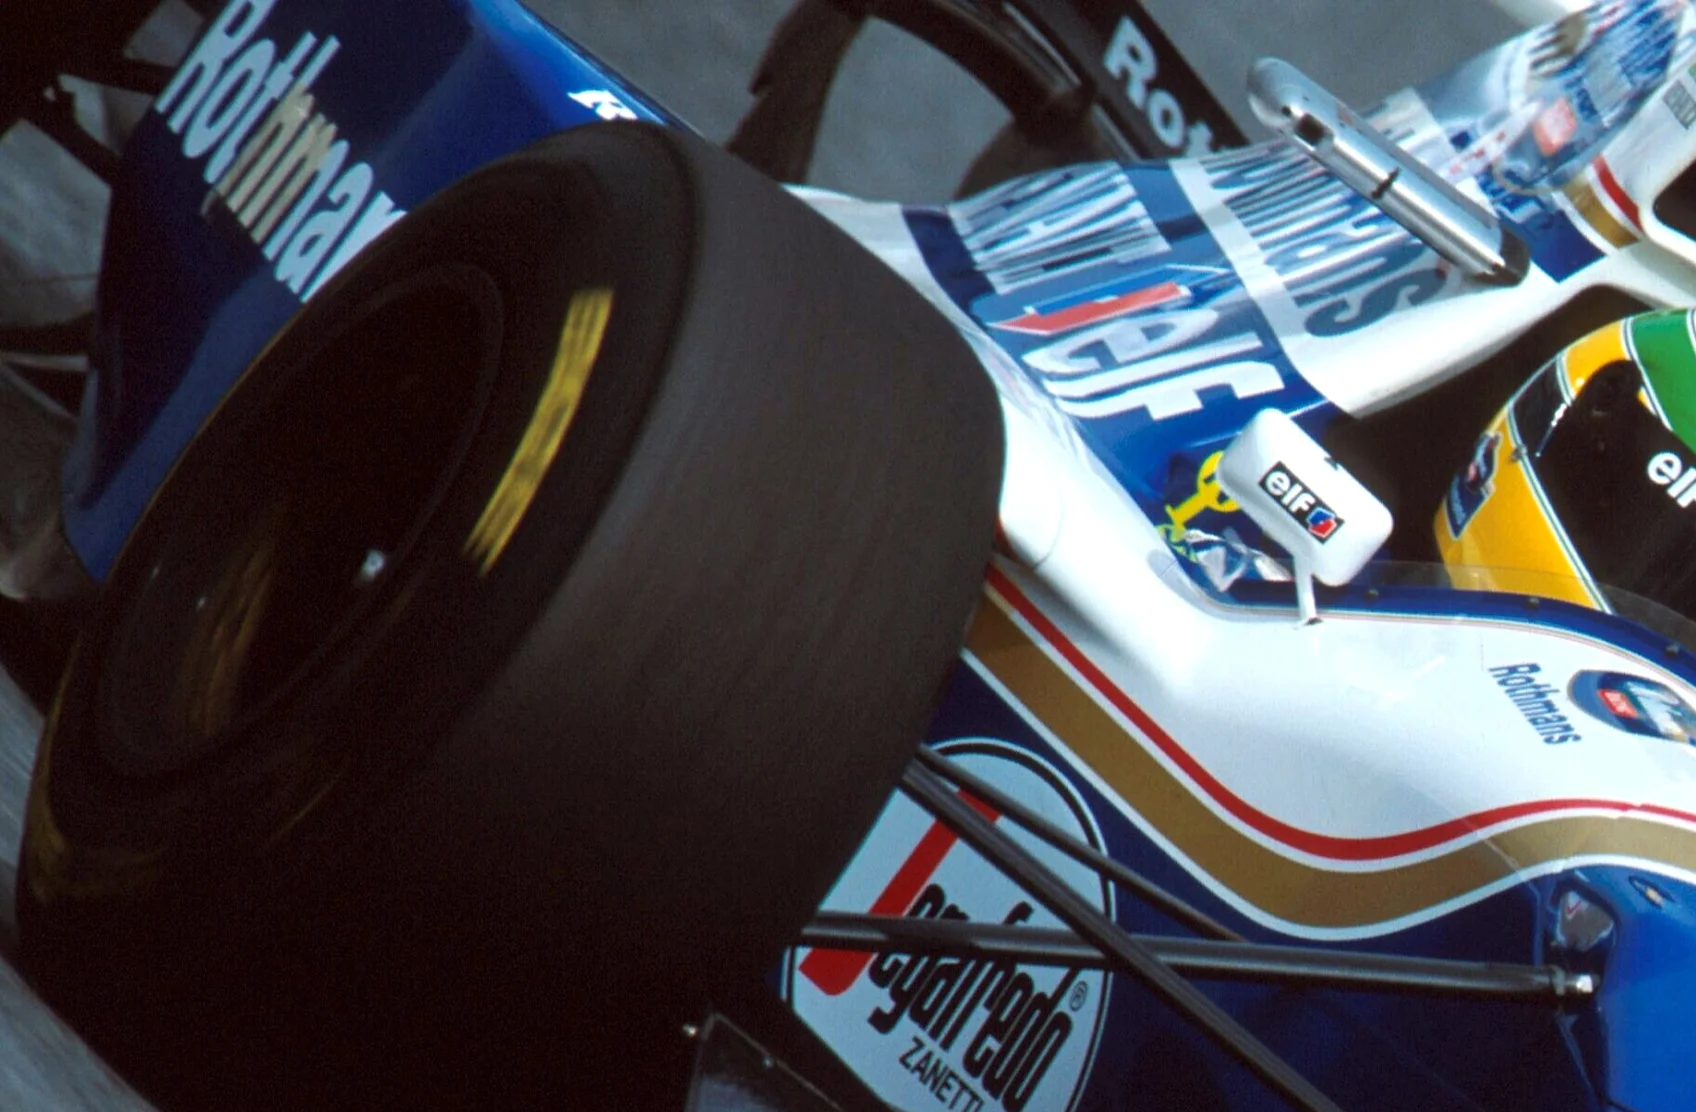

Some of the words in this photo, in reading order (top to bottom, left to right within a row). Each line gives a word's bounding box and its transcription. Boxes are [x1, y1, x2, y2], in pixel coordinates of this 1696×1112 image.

[1022, 308, 1284, 422] elf
[1265, 471, 1315, 514] elf
[1489, 662, 1582, 746] Rothmans
